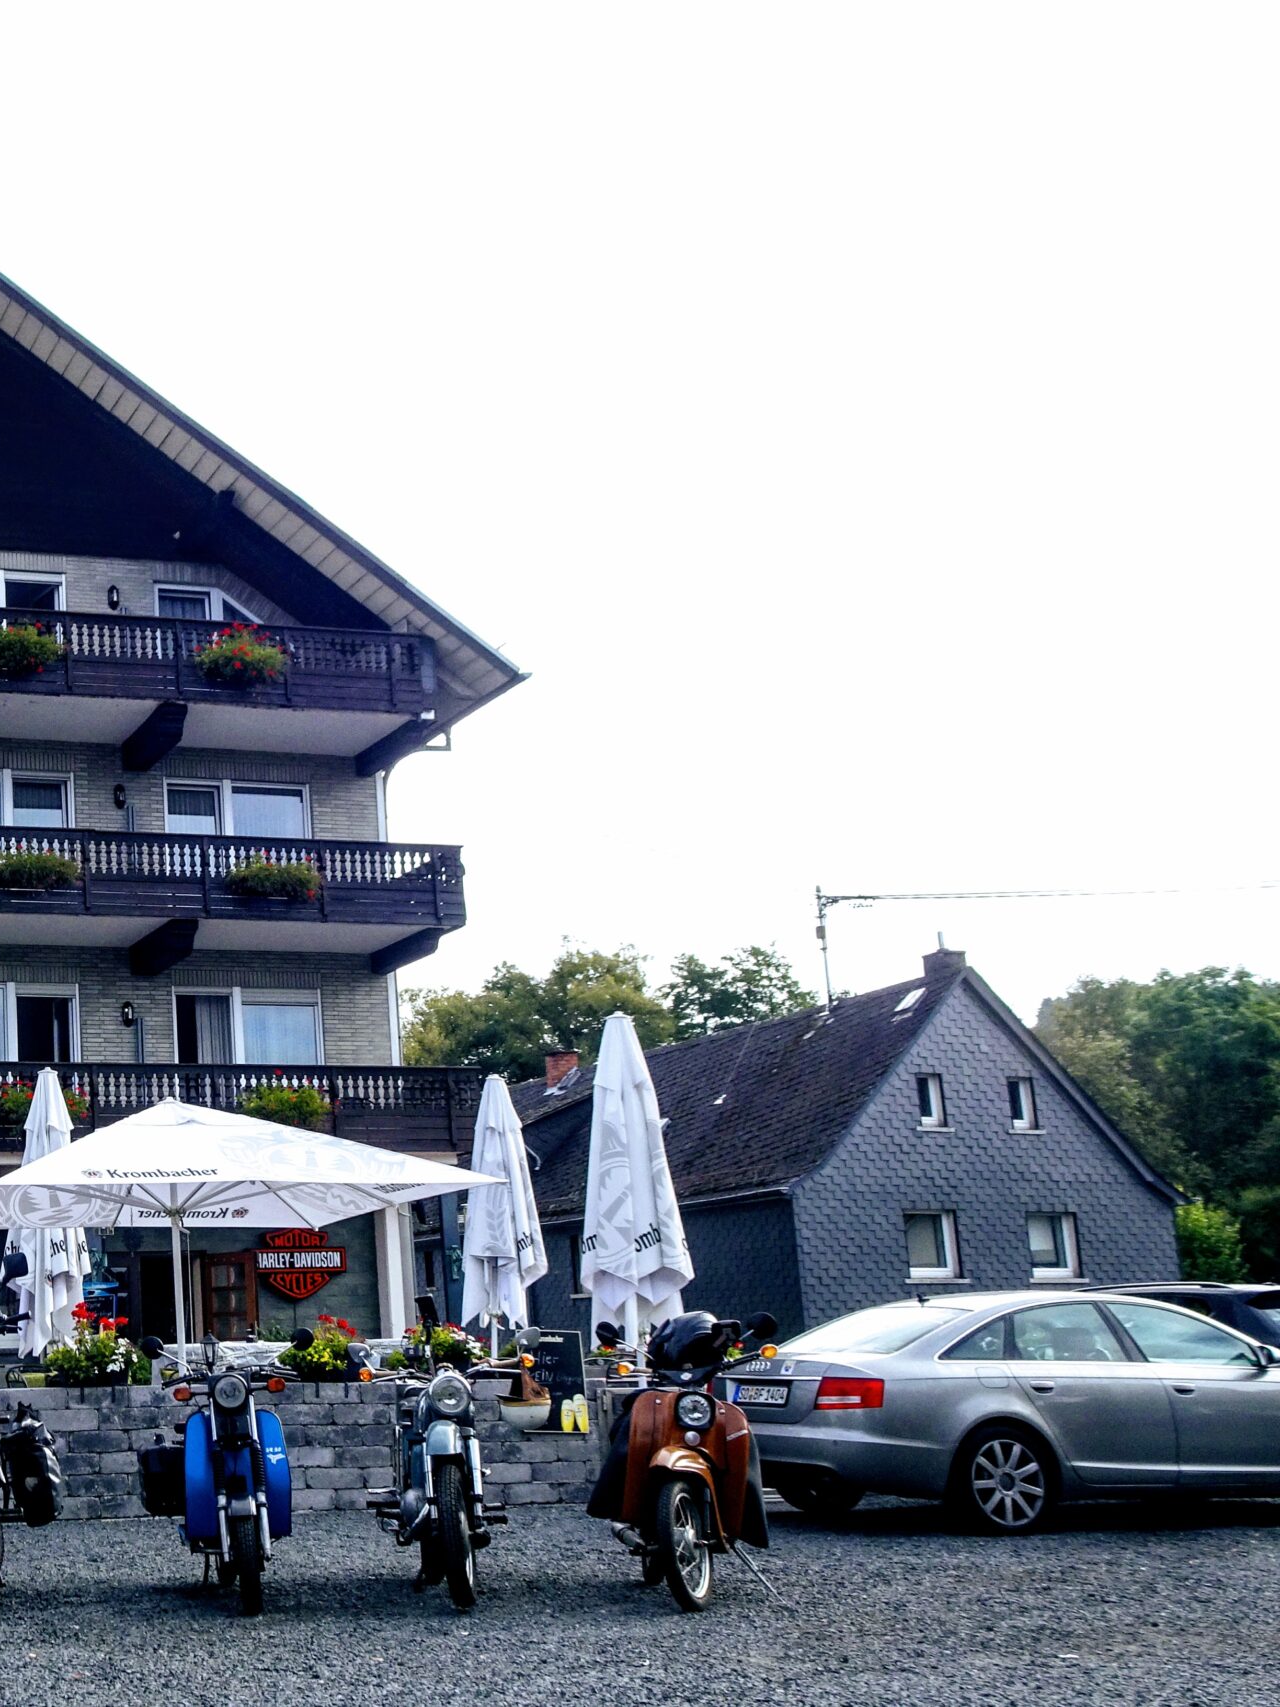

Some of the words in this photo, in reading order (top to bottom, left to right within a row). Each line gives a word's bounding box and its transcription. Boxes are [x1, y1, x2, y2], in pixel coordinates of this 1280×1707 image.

[106, 1168, 218, 1179] Krombacher
[274, 1228, 320, 1247] MOTOR
[276, 1273, 322, 1294] CYCLES
